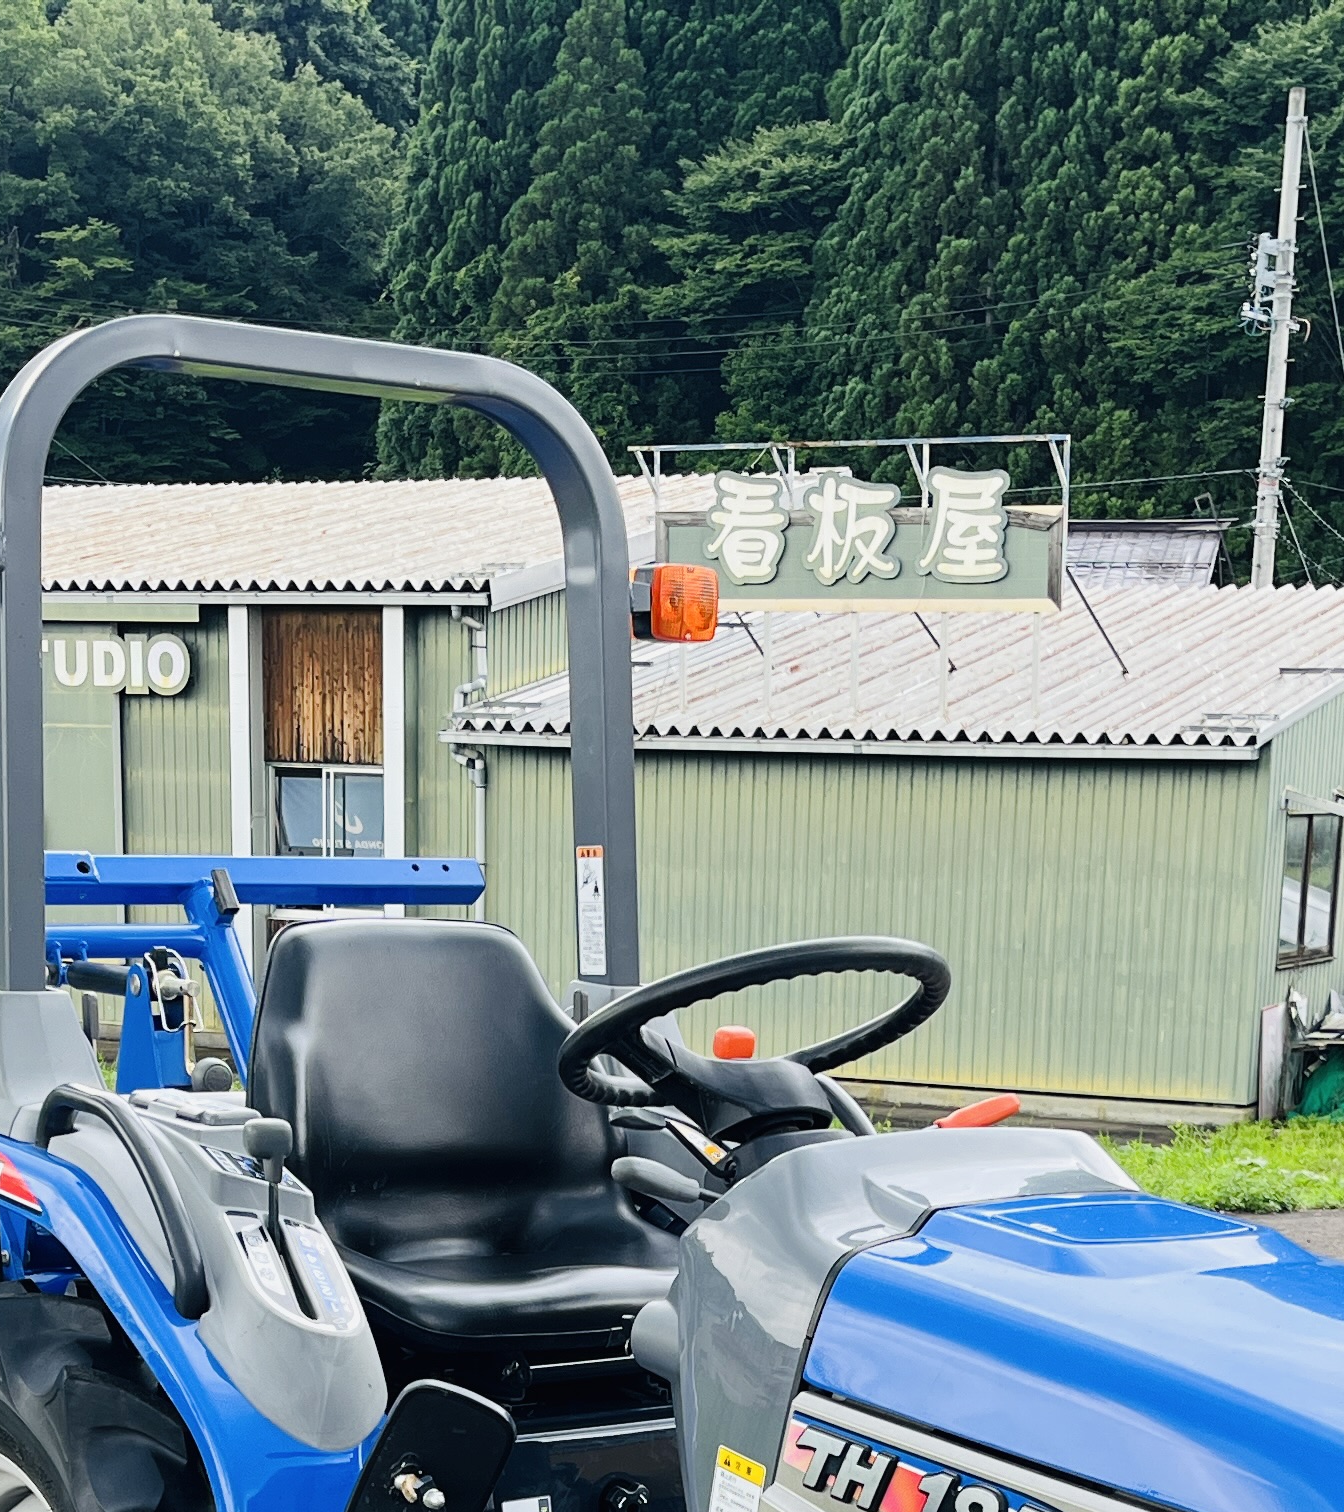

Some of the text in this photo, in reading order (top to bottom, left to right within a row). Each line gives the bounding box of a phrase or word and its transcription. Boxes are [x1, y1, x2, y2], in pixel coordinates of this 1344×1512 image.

[707, 473, 1006, 579] 看板屋
[42, 638, 186, 688] UDIO
[796, 1424, 899, 1512] TH
